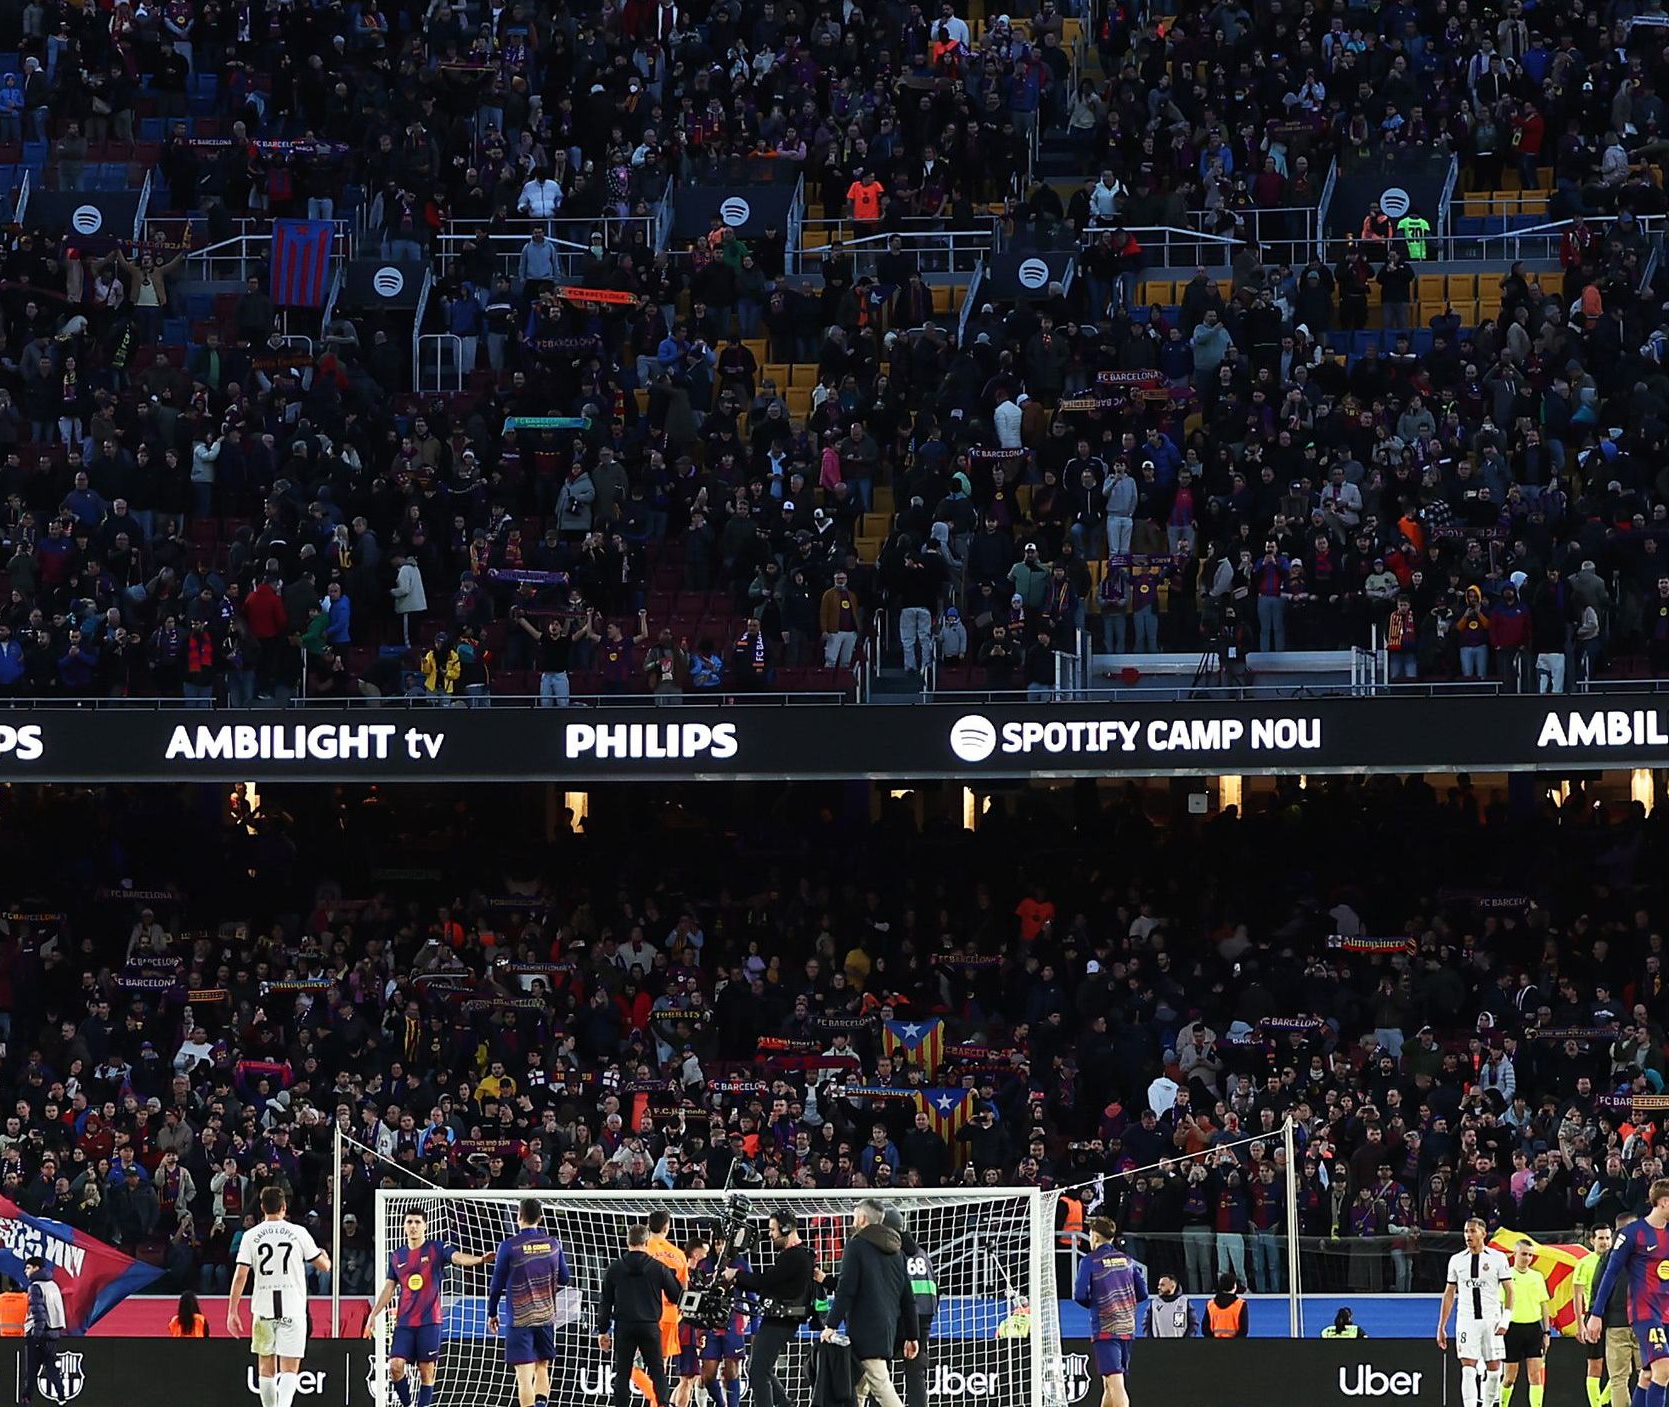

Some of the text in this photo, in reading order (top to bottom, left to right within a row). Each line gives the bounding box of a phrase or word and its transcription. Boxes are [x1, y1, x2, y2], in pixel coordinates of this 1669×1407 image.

[252, 139, 262, 148] FC
[1098, 372, 1159, 382] FC BARCELONA
[971, 449, 1024, 458] FC BARCELONA
[166, 725, 445, 759] AMBILIGHT tv
[567, 724, 738, 758] PHILIPS
[1002, 719, 1320, 752] SPOTIFY CAMP NOU
[1600, 1095, 1611, 1104] FC
[258, 1241, 293, 1275] 27
[906, 1257, 927, 1276] 68
[1647, 1327, 1667, 1343] 43
[1339, 1364, 1422, 1396] Uber
